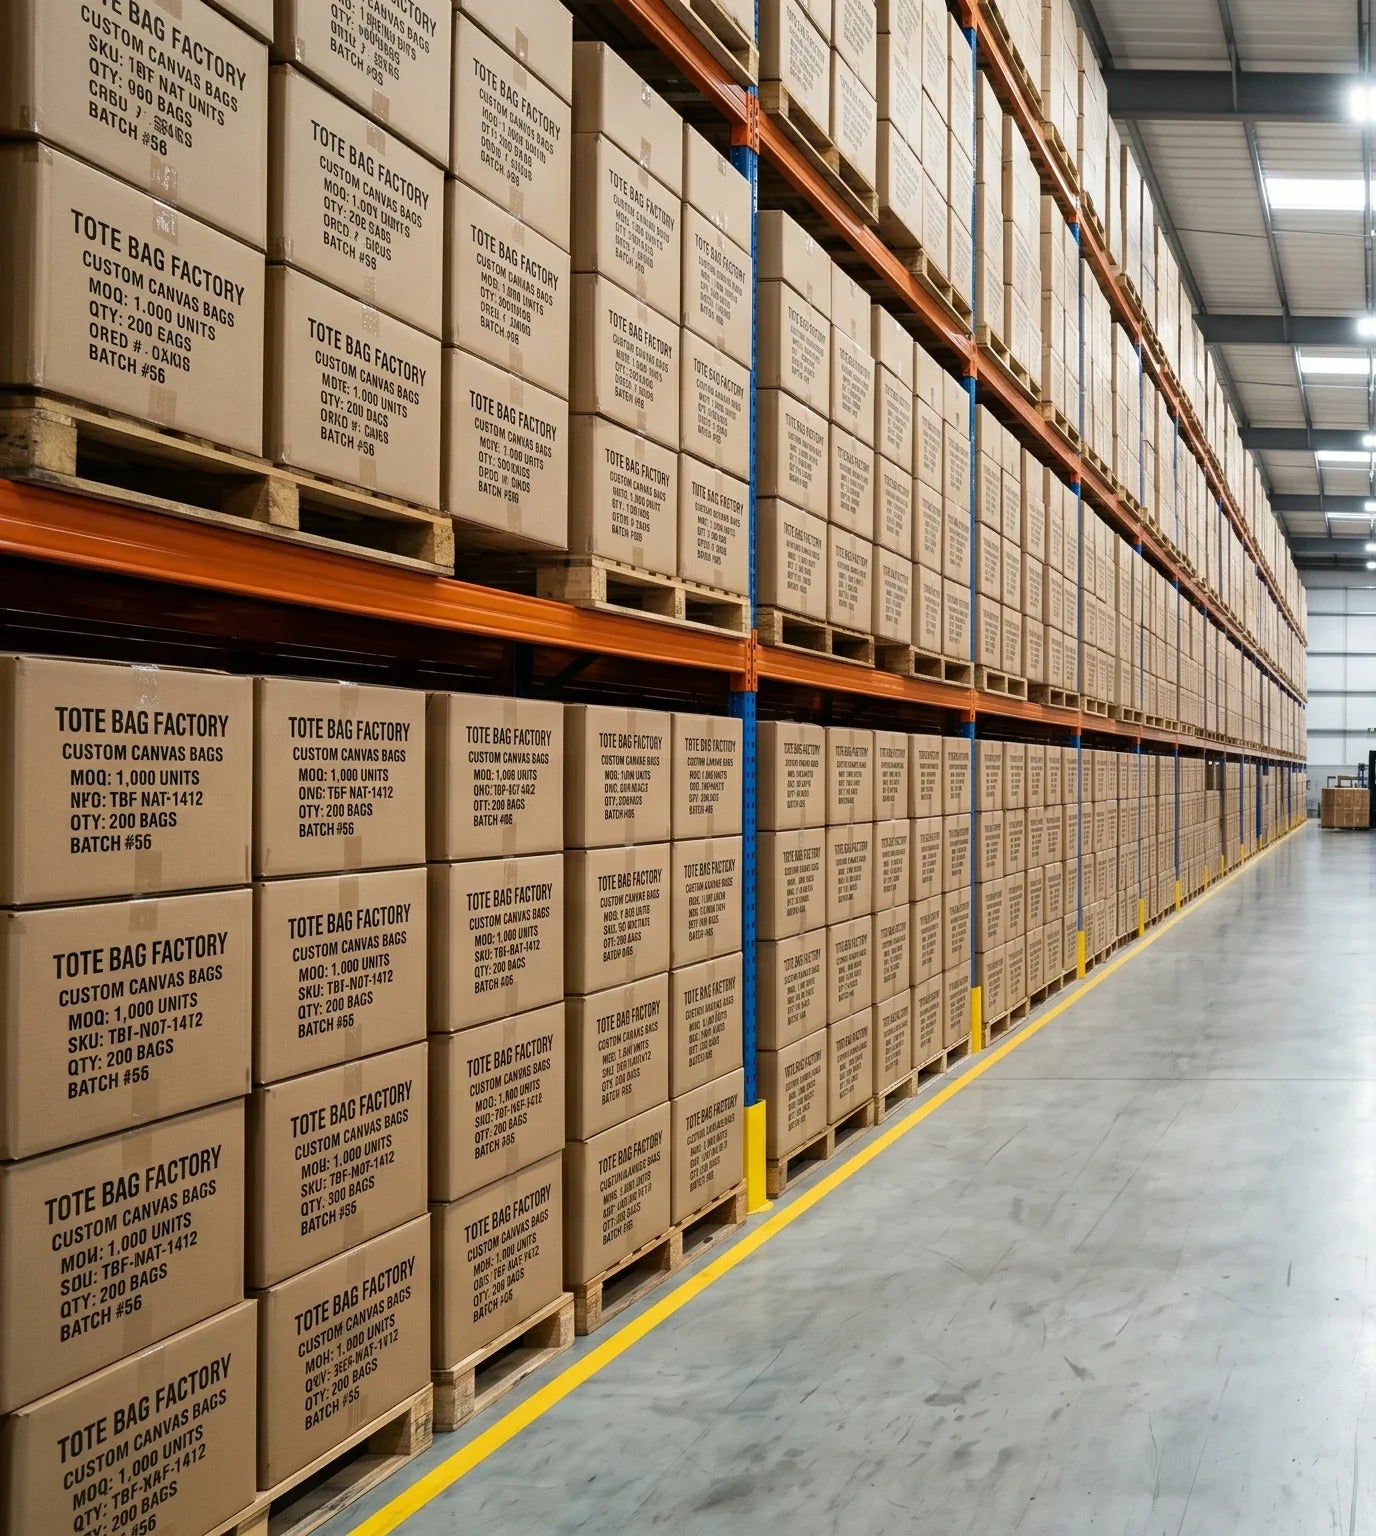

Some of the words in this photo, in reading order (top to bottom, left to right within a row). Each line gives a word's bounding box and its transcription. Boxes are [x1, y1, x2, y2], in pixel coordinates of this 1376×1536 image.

[81, 4, 144, 56] CUSTOM
[148, 45, 201, 91] CANVAS
[205, 80, 238, 113] BAGS
[128, 0, 165, 42] BAG
[172, 26, 247, 91] FACTORY
[310, 119, 346, 159] TOTE
[349, 144, 374, 178] BAG
[378, 163, 429, 211] FACTORY
[70, 208, 122, 253] TOTE
[128, 235, 165, 272] BAG
[171, 254, 245, 306] FACTORY
[82, 250, 144, 290] CUSTOM
[148, 277, 200, 313] CANVAS
[203, 301, 235, 328] BAGS
[89, 276, 128, 307] MOQ:
[176, 312, 216, 341] UNITS
[89, 300, 123, 327] QTY:
[127, 314, 153, 338] 200
[89, 343, 137, 375] BATCH
[141, 362, 166, 384] #56
[307, 317, 342, 351] TOTE
[345, 334, 371, 363] BAG
[374, 347, 427, 387] FACTORY
[54, 706, 106, 733] TOTE
[111, 709, 149, 735] BAG
[153, 711, 229, 738] FACTORY
[288, 716, 324, 739] TOTE
[327, 718, 353, 740] BAG
[356, 720, 411, 742] FACTORY
[465, 725, 491, 744] TOTE
[492, 727, 512, 745] BAG
[513, 728, 552, 747] FACTORY
[62, 742, 127, 761] CUSTOM
[131, 744, 186, 762] CANVAS
[189, 746, 224, 762] BAGS
[70, 769, 112, 787] MOQ:
[115, 769, 156, 788] 1,000
[159, 769, 200, 786] UNITS
[109, 791, 138, 808] TBF
[109, 812, 136, 830] 200
[139, 811, 177, 829] BAGS
[70, 834, 121, 854] BATCH
[124, 833, 152, 850] #56
[466, 890, 491, 912] TOTE
[493, 887, 513, 908] BAG
[514, 882, 553, 905] FACTORY
[287, 914, 324, 940] TOTE
[327, 910, 353, 934] BAG
[356, 903, 412, 930] FACTORY
[52, 948, 104, 980] TOTE
[109, 942, 147, 972] BAG
[151, 931, 228, 966] FACTORY
[59, 980, 124, 1007] CUSTOM
[129, 971, 185, 996] CANVAS
[188, 964, 223, 985] BAGS
[68, 1009, 109, 1031] MOQ:
[114, 999, 154, 1024] 1,000
[158, 992, 198, 1014] UNITS
[68, 1032, 104, 1054] SKU:
[68, 1054, 102, 1077] QTY:
[106, 1047, 133, 1068] 200
[137, 1038, 174, 1061] BAGS
[466, 1053, 492, 1078] TOTE
[514, 1033, 554, 1063] FACTORY
[68, 1072, 119, 1100] BATCH
[290, 1107, 327, 1139] TOTE
[329, 1098, 356, 1126] BAG
[359, 1080, 413, 1117] FACTORY
[44, 1185, 96, 1225] TOTE
[102, 1172, 140, 1208] BAG
[145, 1144, 222, 1193] FACTORY
[464, 1215, 490, 1244] TOTE
[491, 1204, 512, 1231] BAG
[512, 1183, 552, 1220] FACTORY
[294, 1299, 330, 1336] TOTE
[332, 1285, 359, 1317] BAG
[362, 1255, 416, 1301] FACTORY
[57, 1416, 107, 1464] TOTE
[113, 1395, 150, 1436] BAG
[155, 1352, 232, 1414] FACTORY
